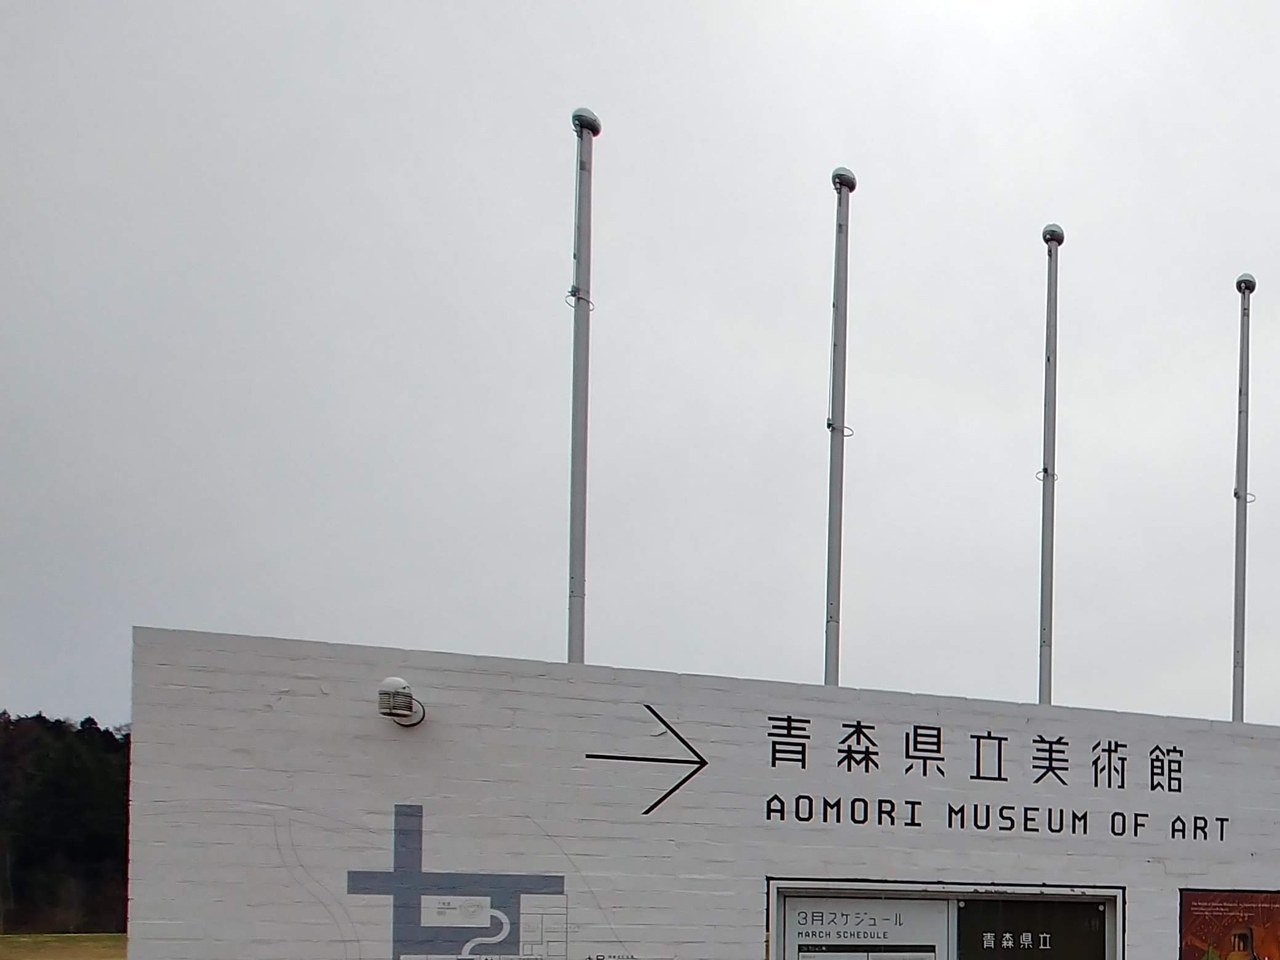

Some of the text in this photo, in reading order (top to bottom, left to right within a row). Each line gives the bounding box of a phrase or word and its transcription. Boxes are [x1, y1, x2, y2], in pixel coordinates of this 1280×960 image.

[766, 714, 1185, 793] 青森県立美術館
[765, 793, 1231, 842] AOMORI MUSEUM OF ART
[797, 910, 905, 928] 3月スケジュール
[797, 930, 889, 940] MARCH SCHEDULE
[982, 932, 1052, 949] 青森県立
